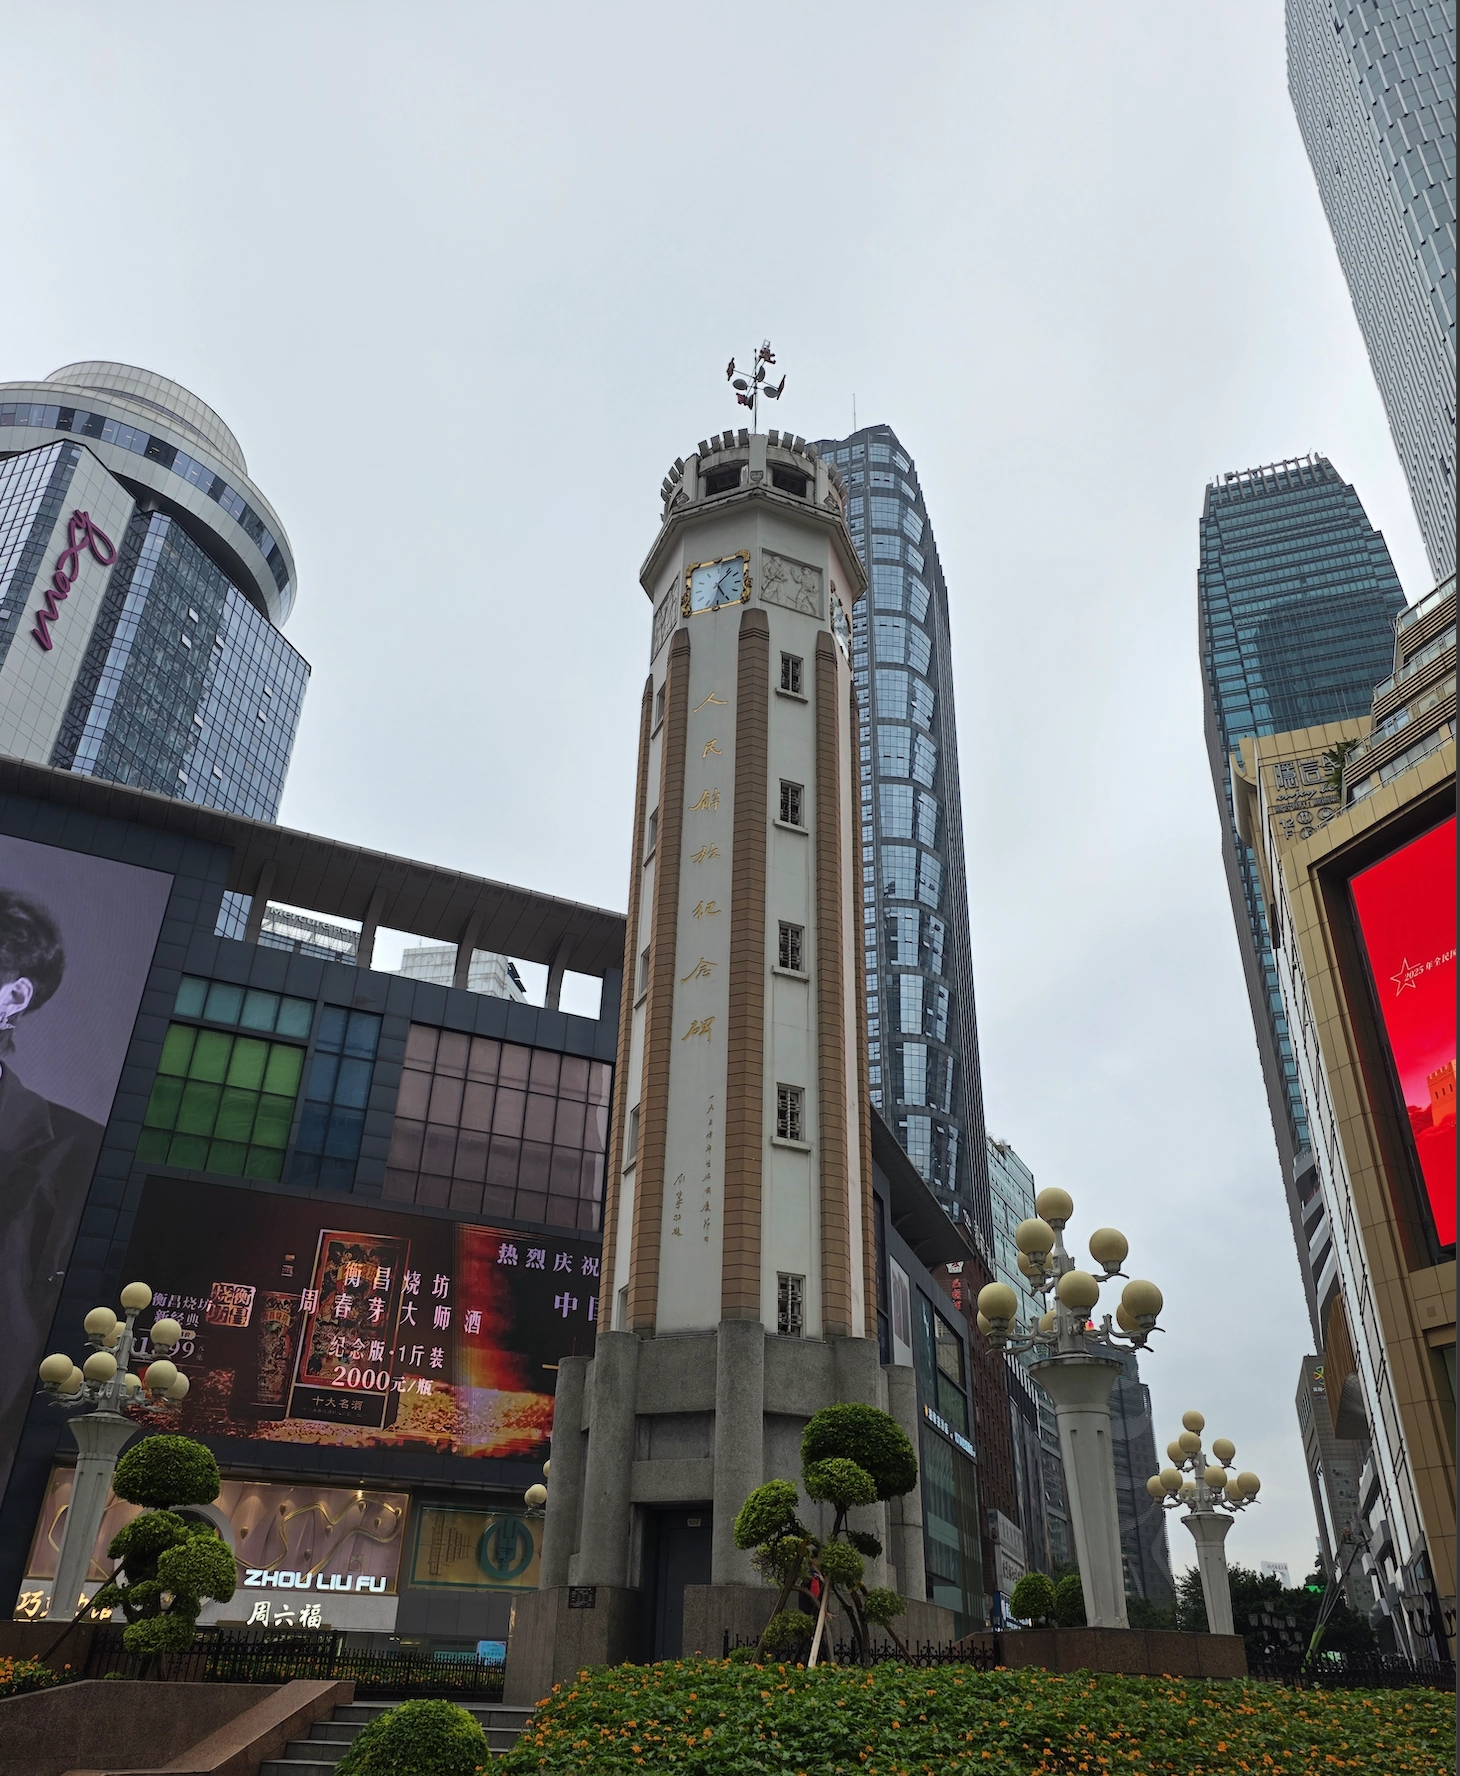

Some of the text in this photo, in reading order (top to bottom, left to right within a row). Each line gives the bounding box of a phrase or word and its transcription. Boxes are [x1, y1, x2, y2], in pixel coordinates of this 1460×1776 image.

[1280, 818, 1295, 829] 12
[1284, 830, 1293, 840] F
[270, 906, 330, 929] Mercure
[497, 1243, 600, 1277] 热烈庆祝
[344, 1261, 451, 1300] 衡昌烧坊
[298, 1288, 482, 1335] 周春芽大师酒
[312, 1396, 364, 1411] 十大名酒
[244, 1569, 387, 1592] ZHOU LIU FU
[246, 1600, 323, 1629] 周六福
